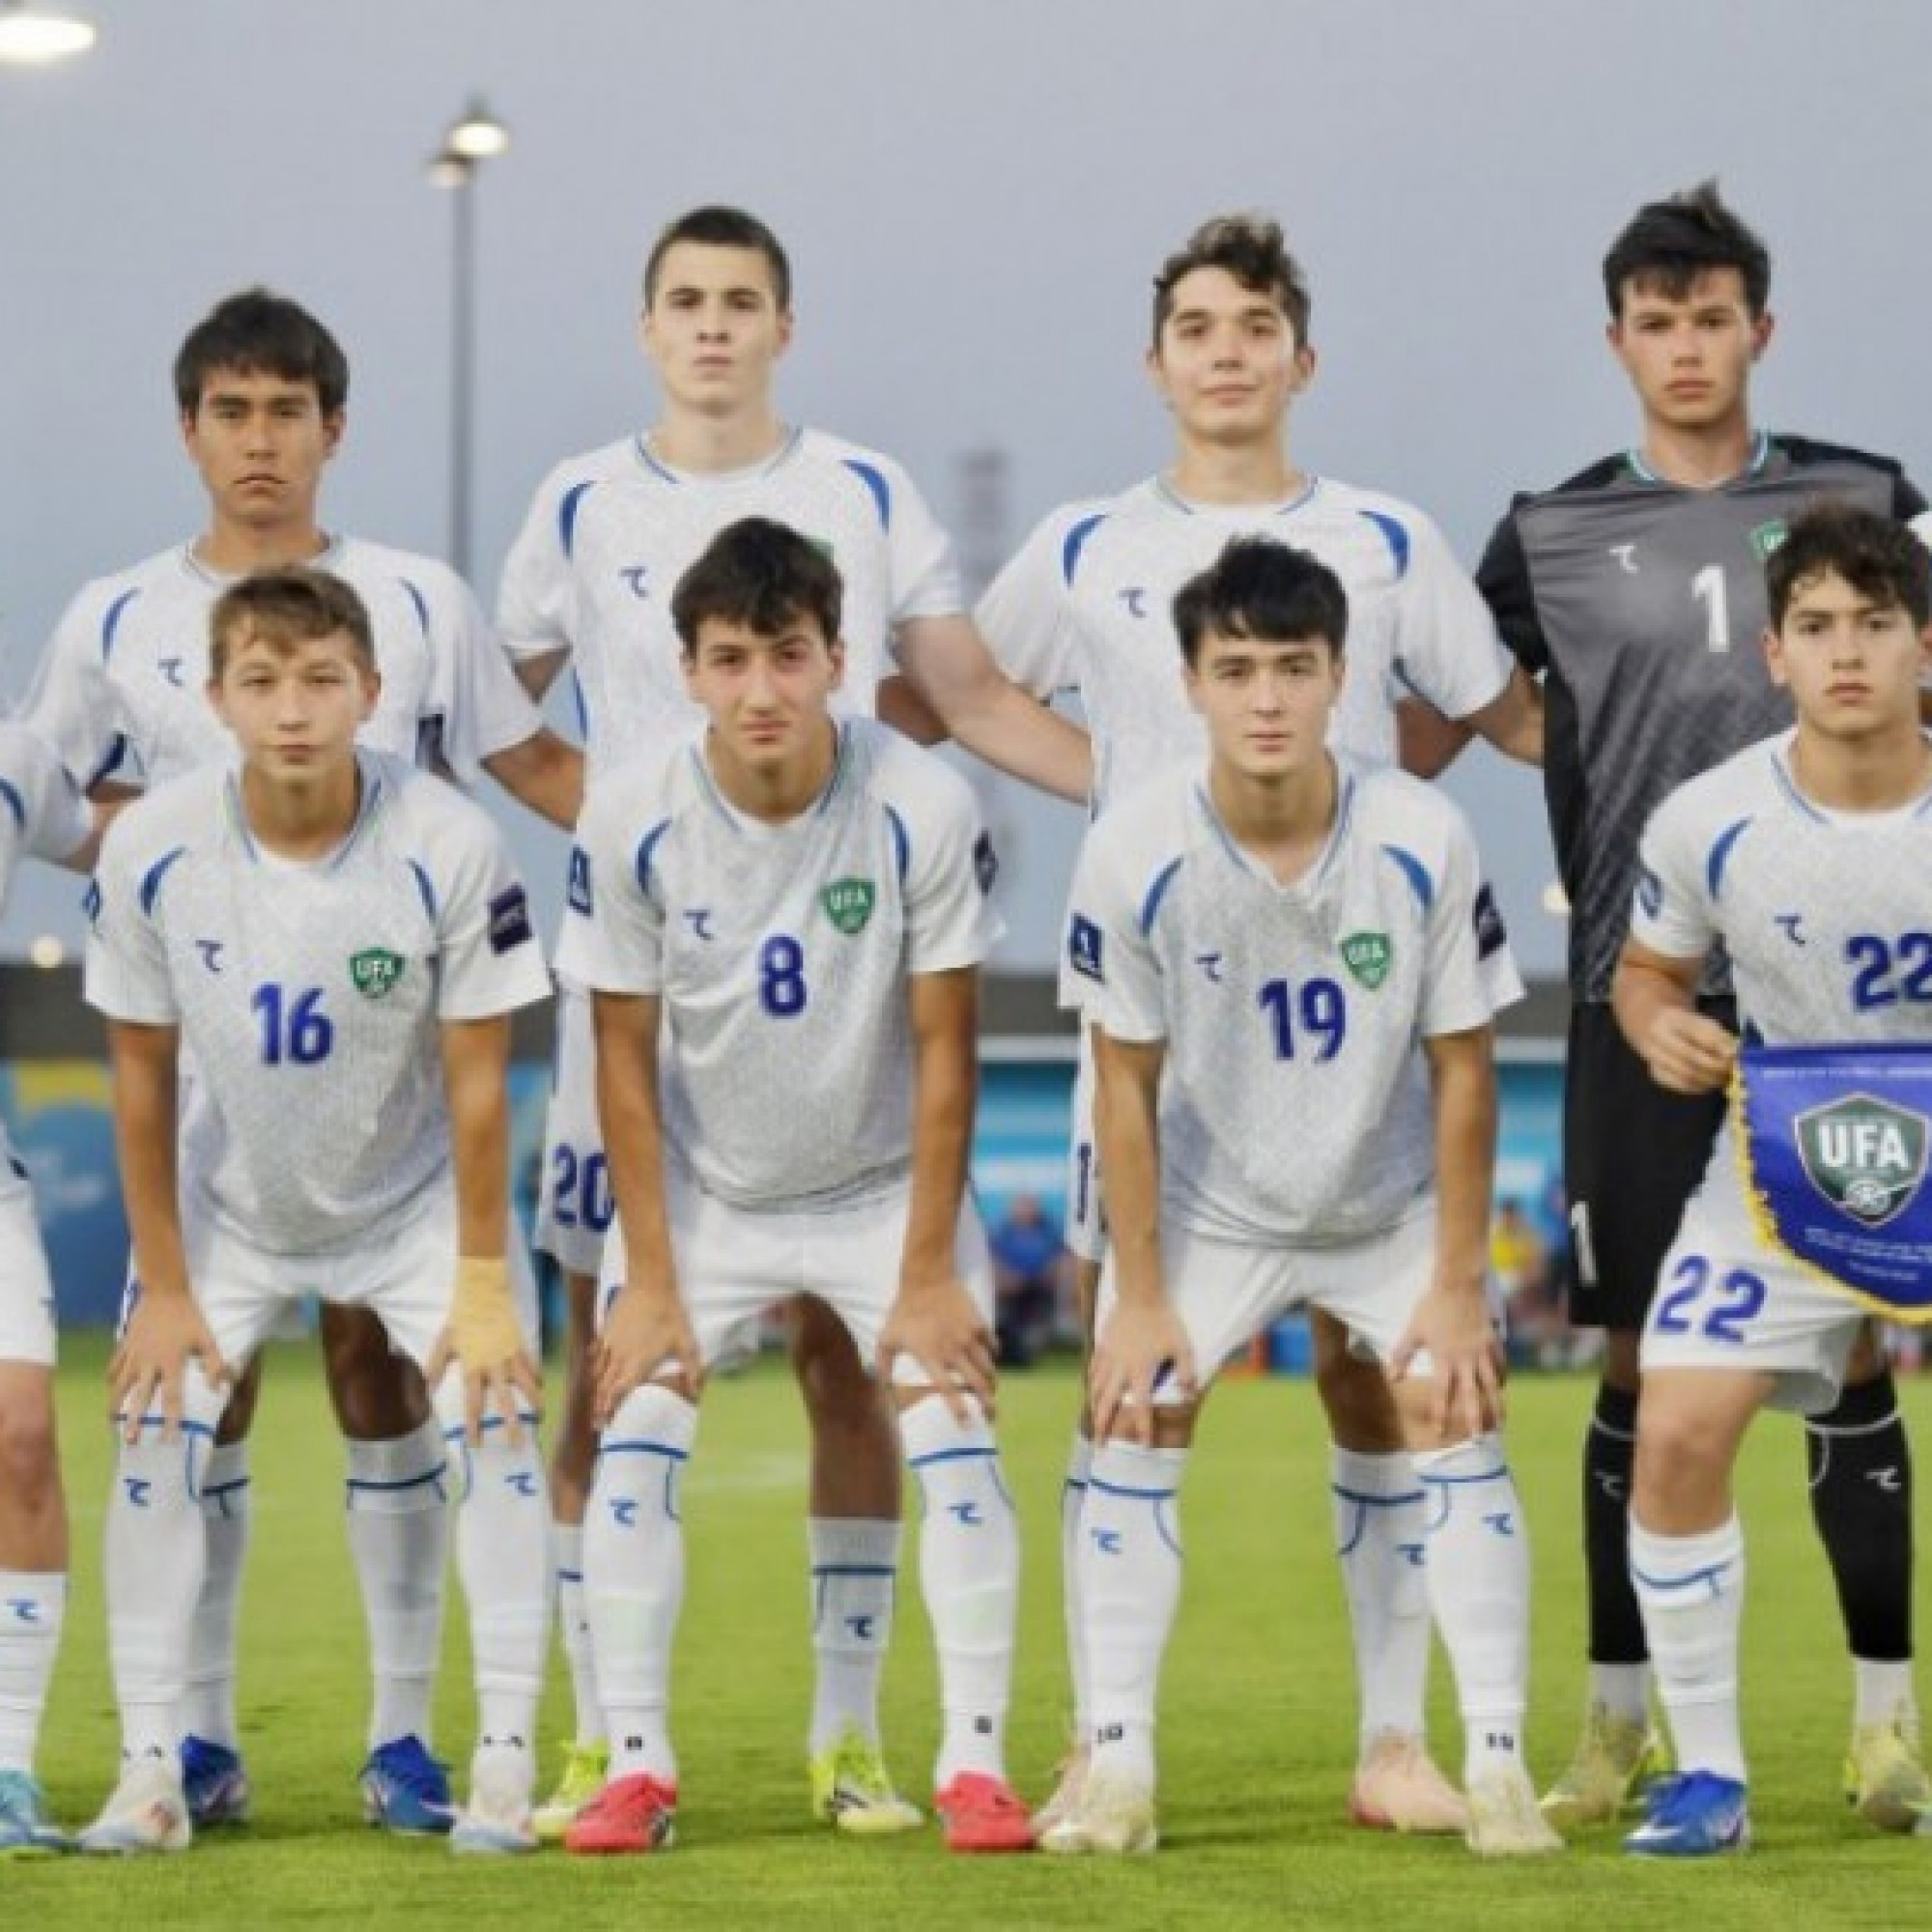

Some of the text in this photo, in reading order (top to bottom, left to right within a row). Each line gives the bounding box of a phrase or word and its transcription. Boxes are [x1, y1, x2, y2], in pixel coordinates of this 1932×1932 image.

[1691, 563, 1730, 653] 1
[759, 936, 807, 1017] 8
[1844, 933, 1932, 1011] 22
[251, 983, 333, 1065] 16
[1259, 978, 1347, 1062] 19
[1818, 1124, 1910, 1168] UFA
[1571, 1201, 1597, 1286] 1
[1656, 1256, 1767, 1343] 22
